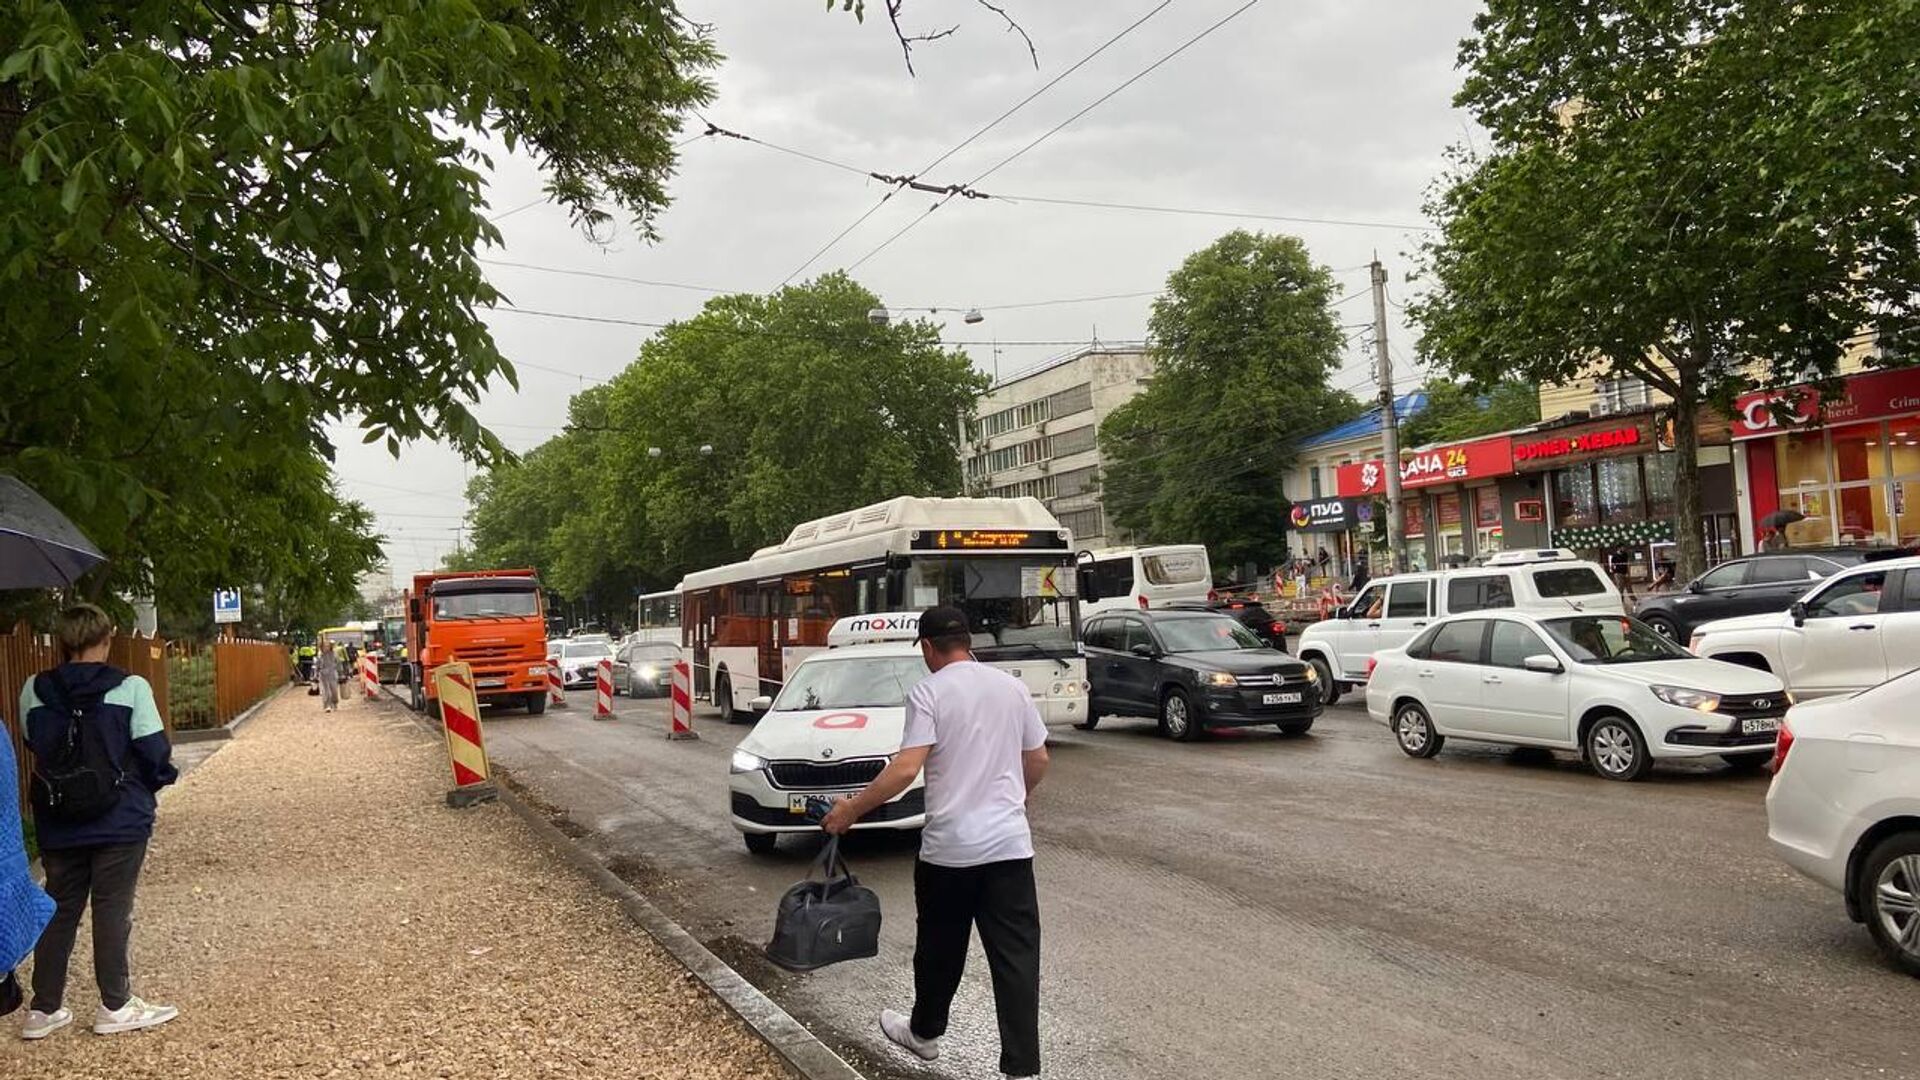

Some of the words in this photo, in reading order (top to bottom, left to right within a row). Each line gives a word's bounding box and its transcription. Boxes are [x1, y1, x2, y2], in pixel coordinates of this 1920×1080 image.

[1447, 448, 1467, 467] 24
[1311, 502, 1344, 517] ПУД
[938, 531, 947, 548] 4
